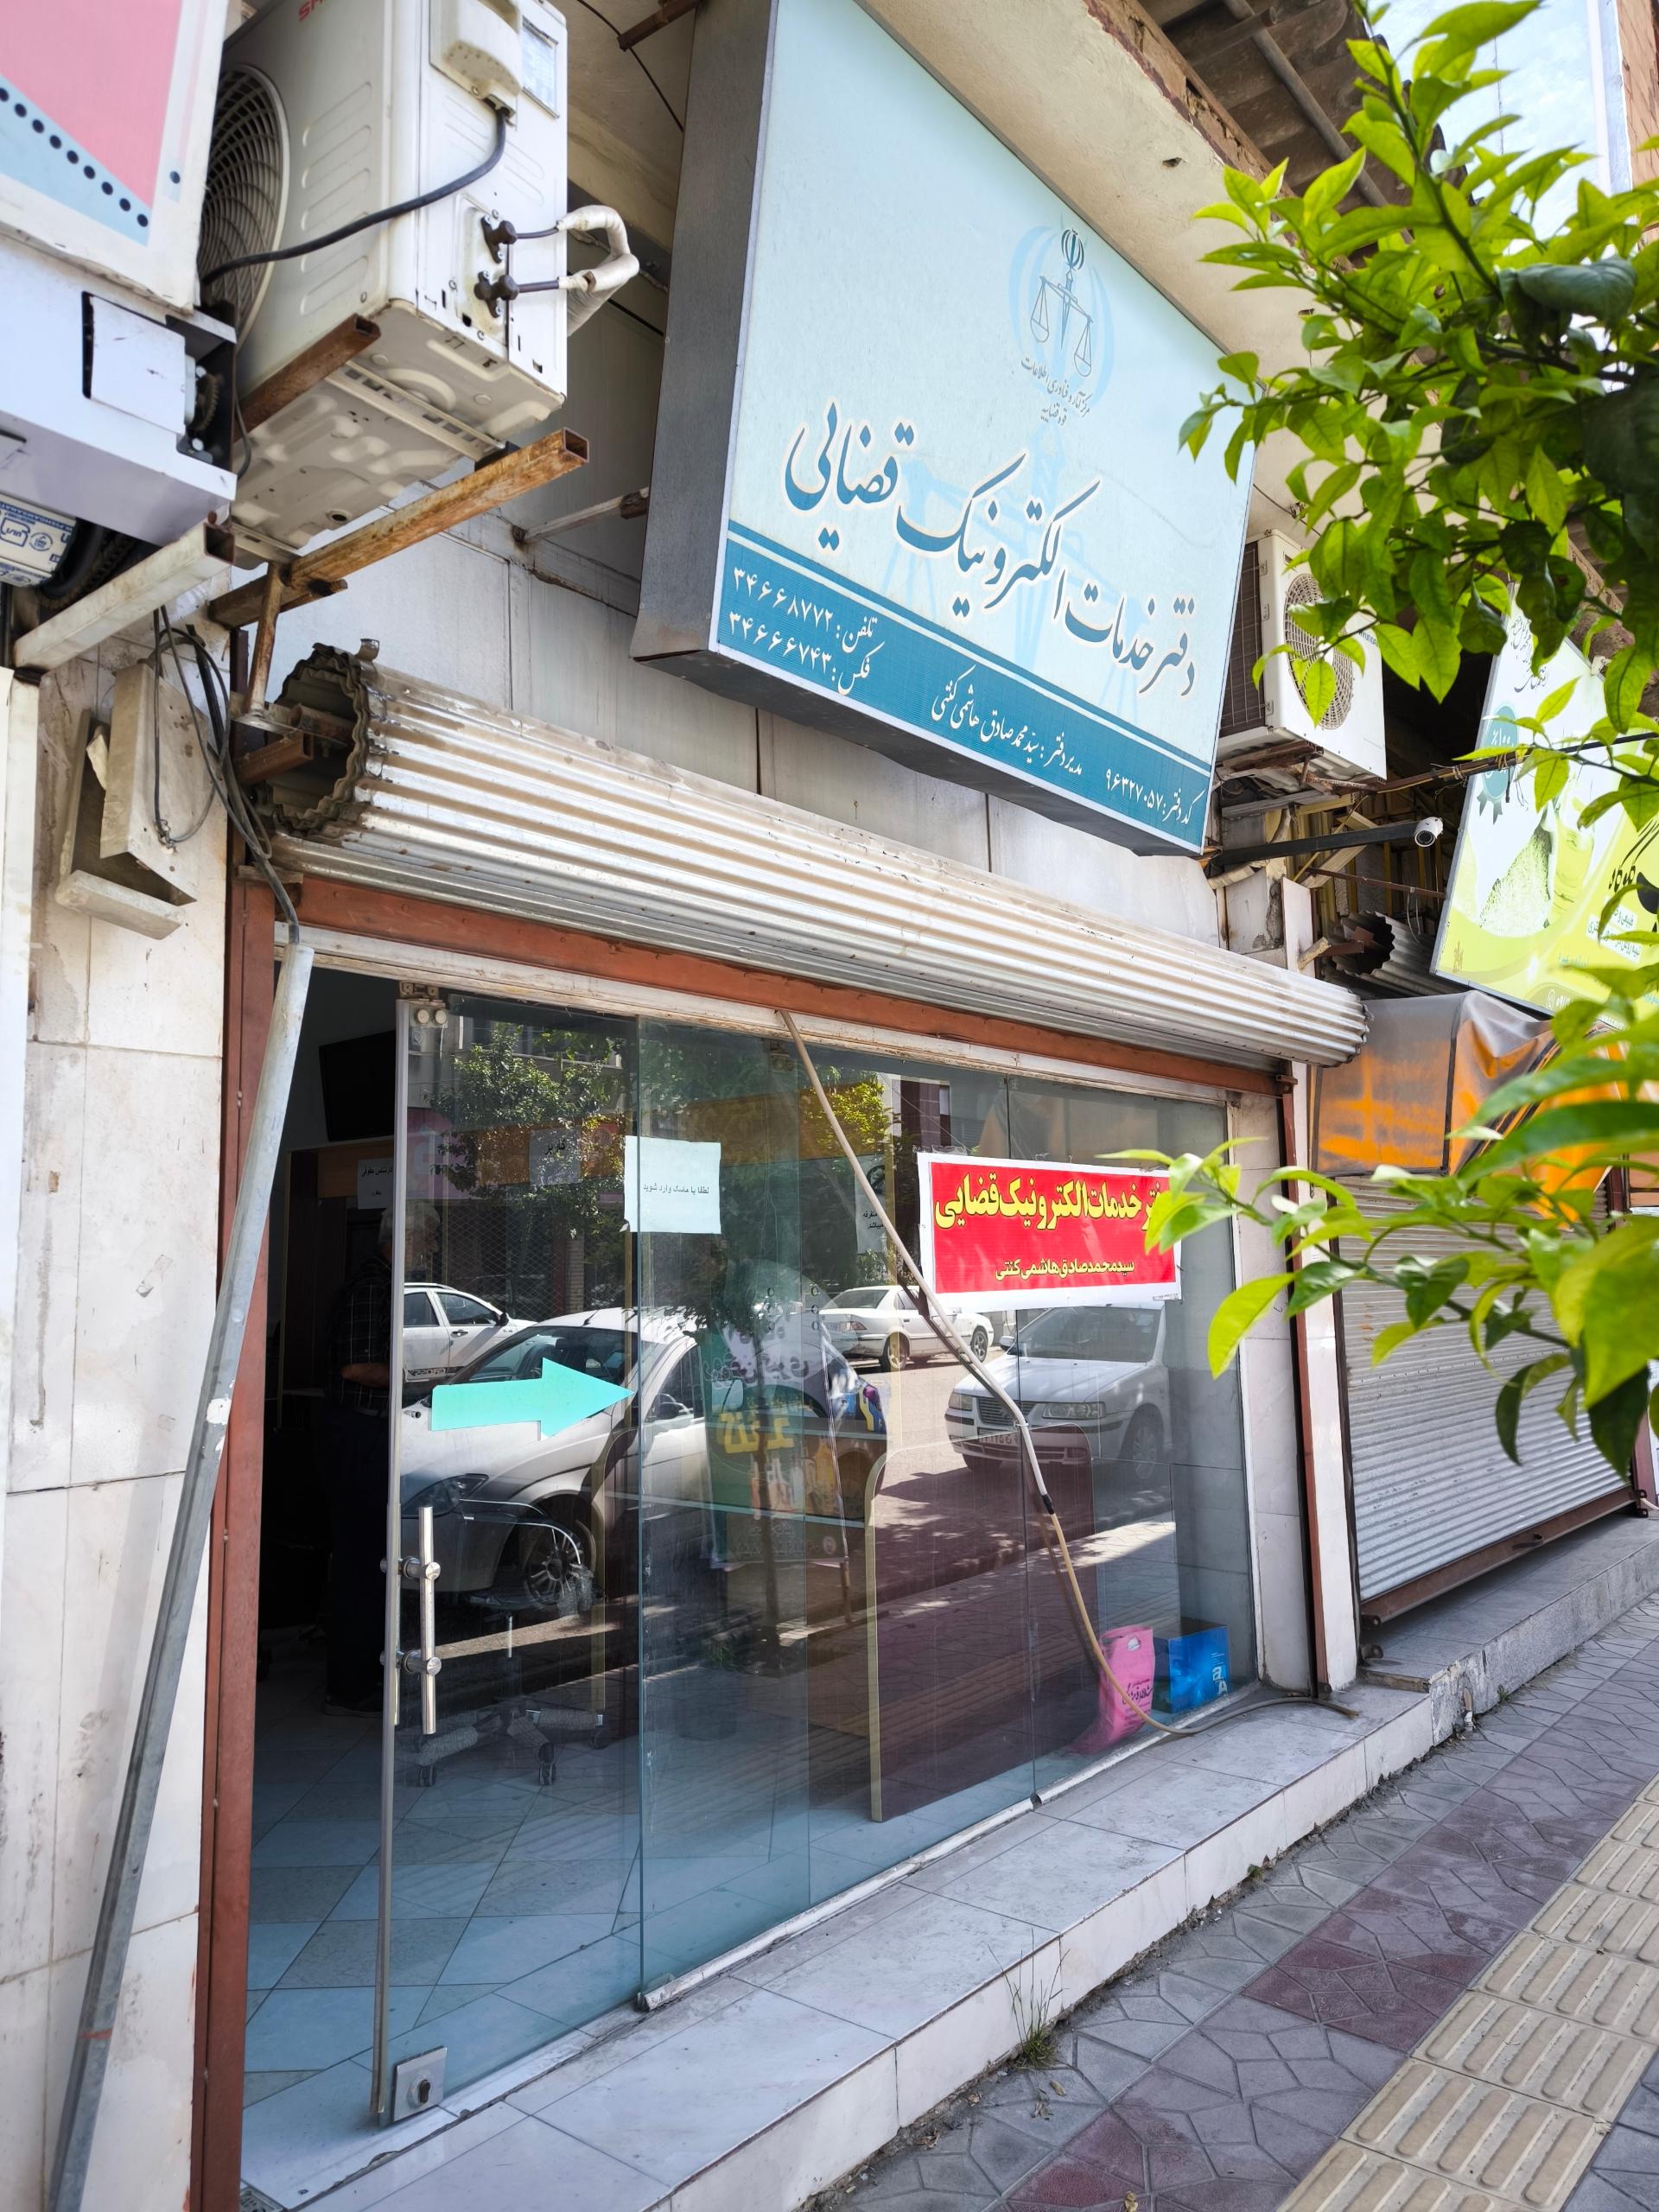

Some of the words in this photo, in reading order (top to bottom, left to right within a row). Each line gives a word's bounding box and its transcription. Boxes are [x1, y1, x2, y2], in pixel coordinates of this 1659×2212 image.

[898, 452, 1101, 620] الکترونیک
[1065, 583, 1155, 671] خدمات
[1139, 596, 1195, 696] دفتر
[950, 683, 980, 729] هاشمی
[980, 709, 1014, 742] صادق
[935, 1172, 1000, 1229] قضایی
[1000, 1177, 1088, 1230] الکترونیک
[1088, 1180, 1141, 1219] خدمات
